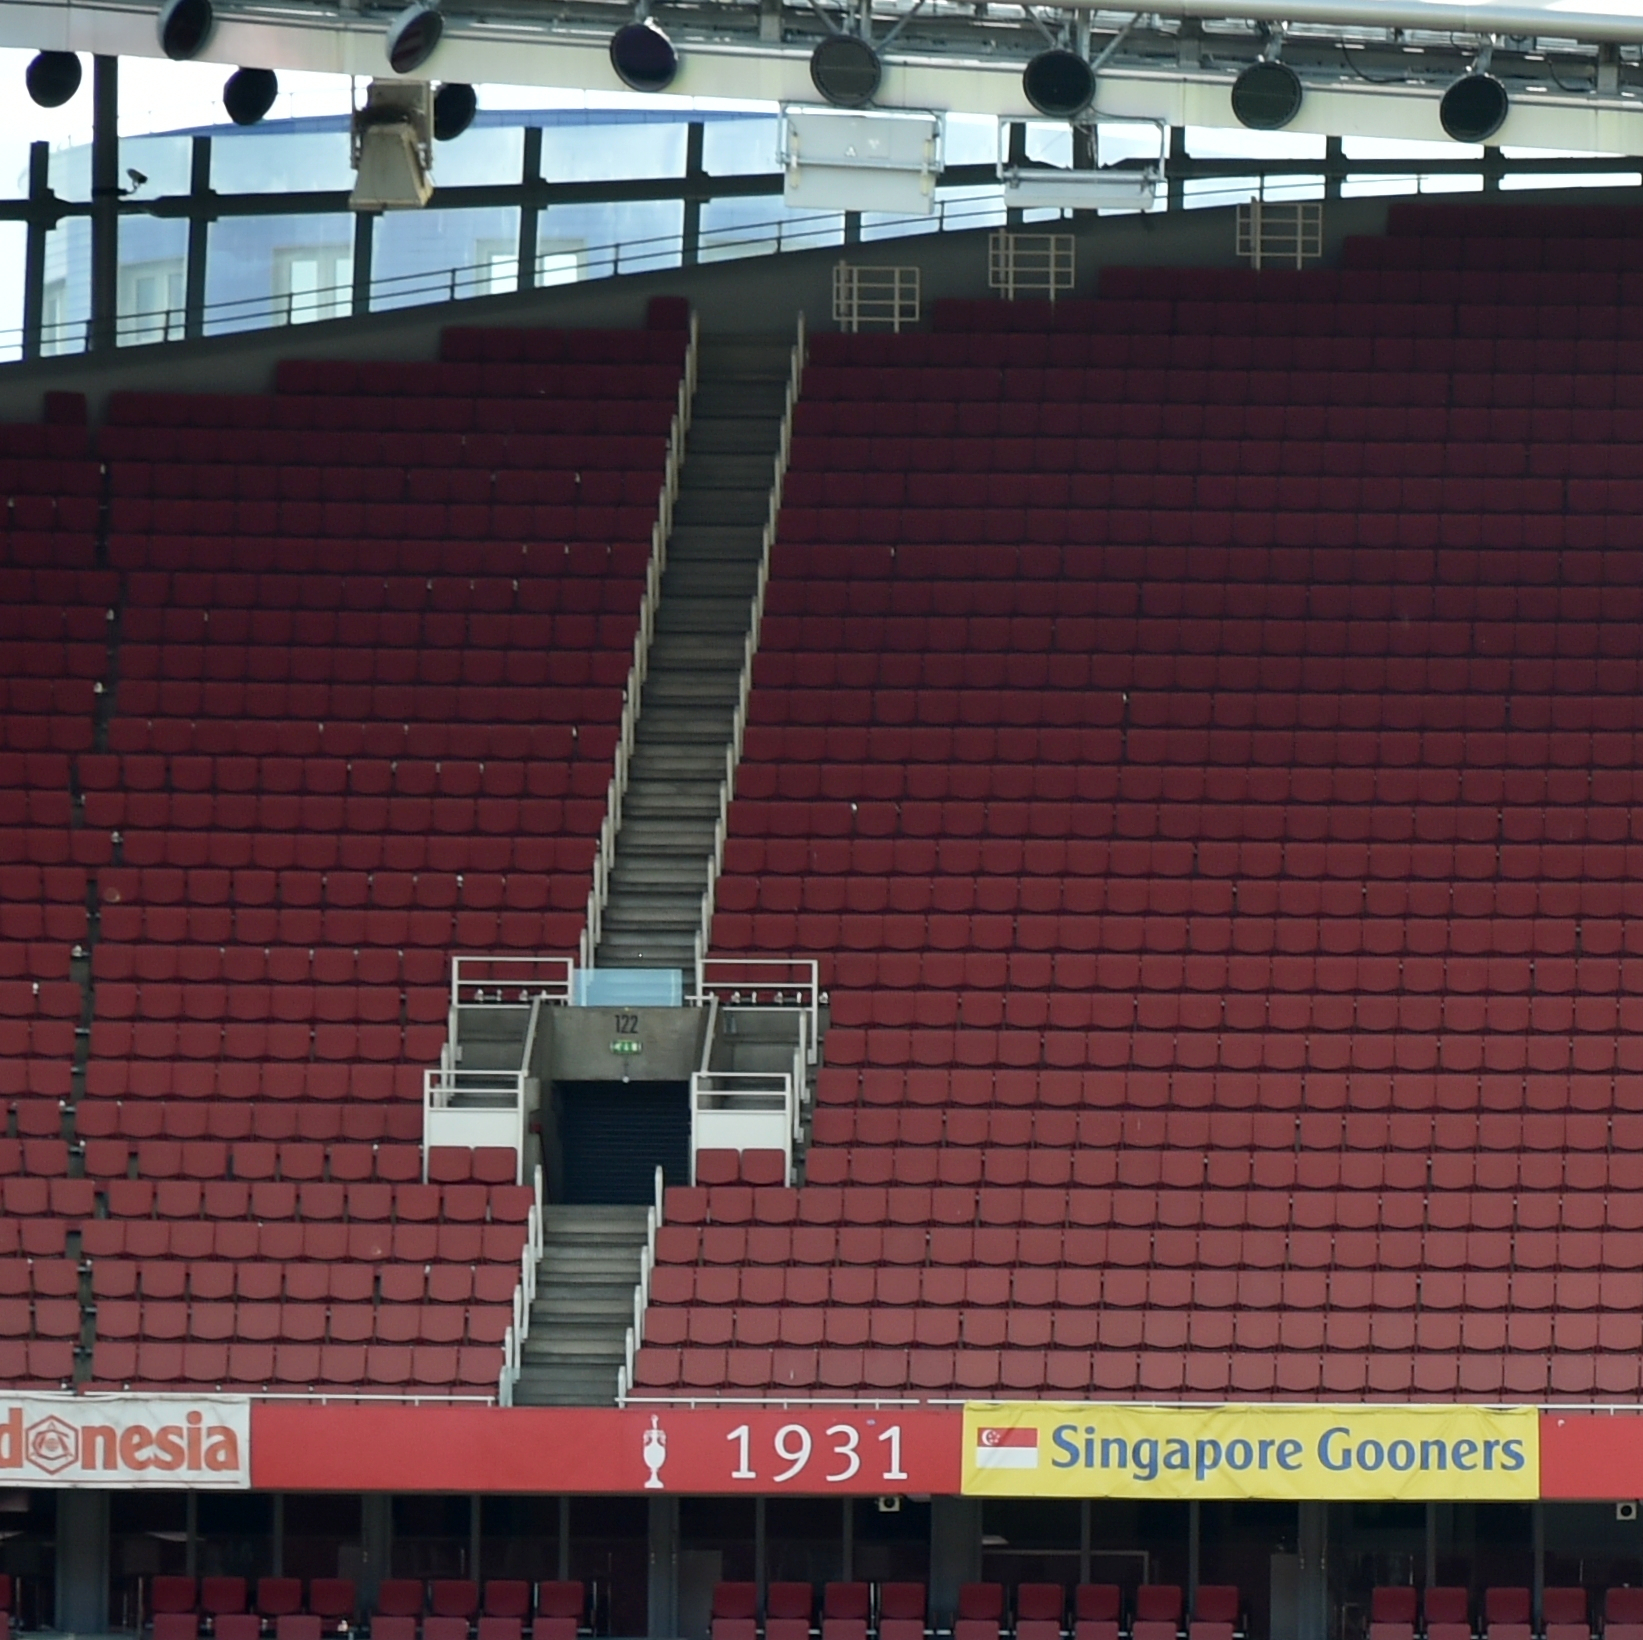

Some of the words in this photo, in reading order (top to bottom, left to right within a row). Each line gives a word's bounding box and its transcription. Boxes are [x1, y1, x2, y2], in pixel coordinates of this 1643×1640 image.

[614, 1015, 639, 1034] 122
[727, 1425, 908, 1481] 1931
[1052, 1424, 1302, 1480] Singapore
[1317, 1427, 1524, 1471] Gooners
